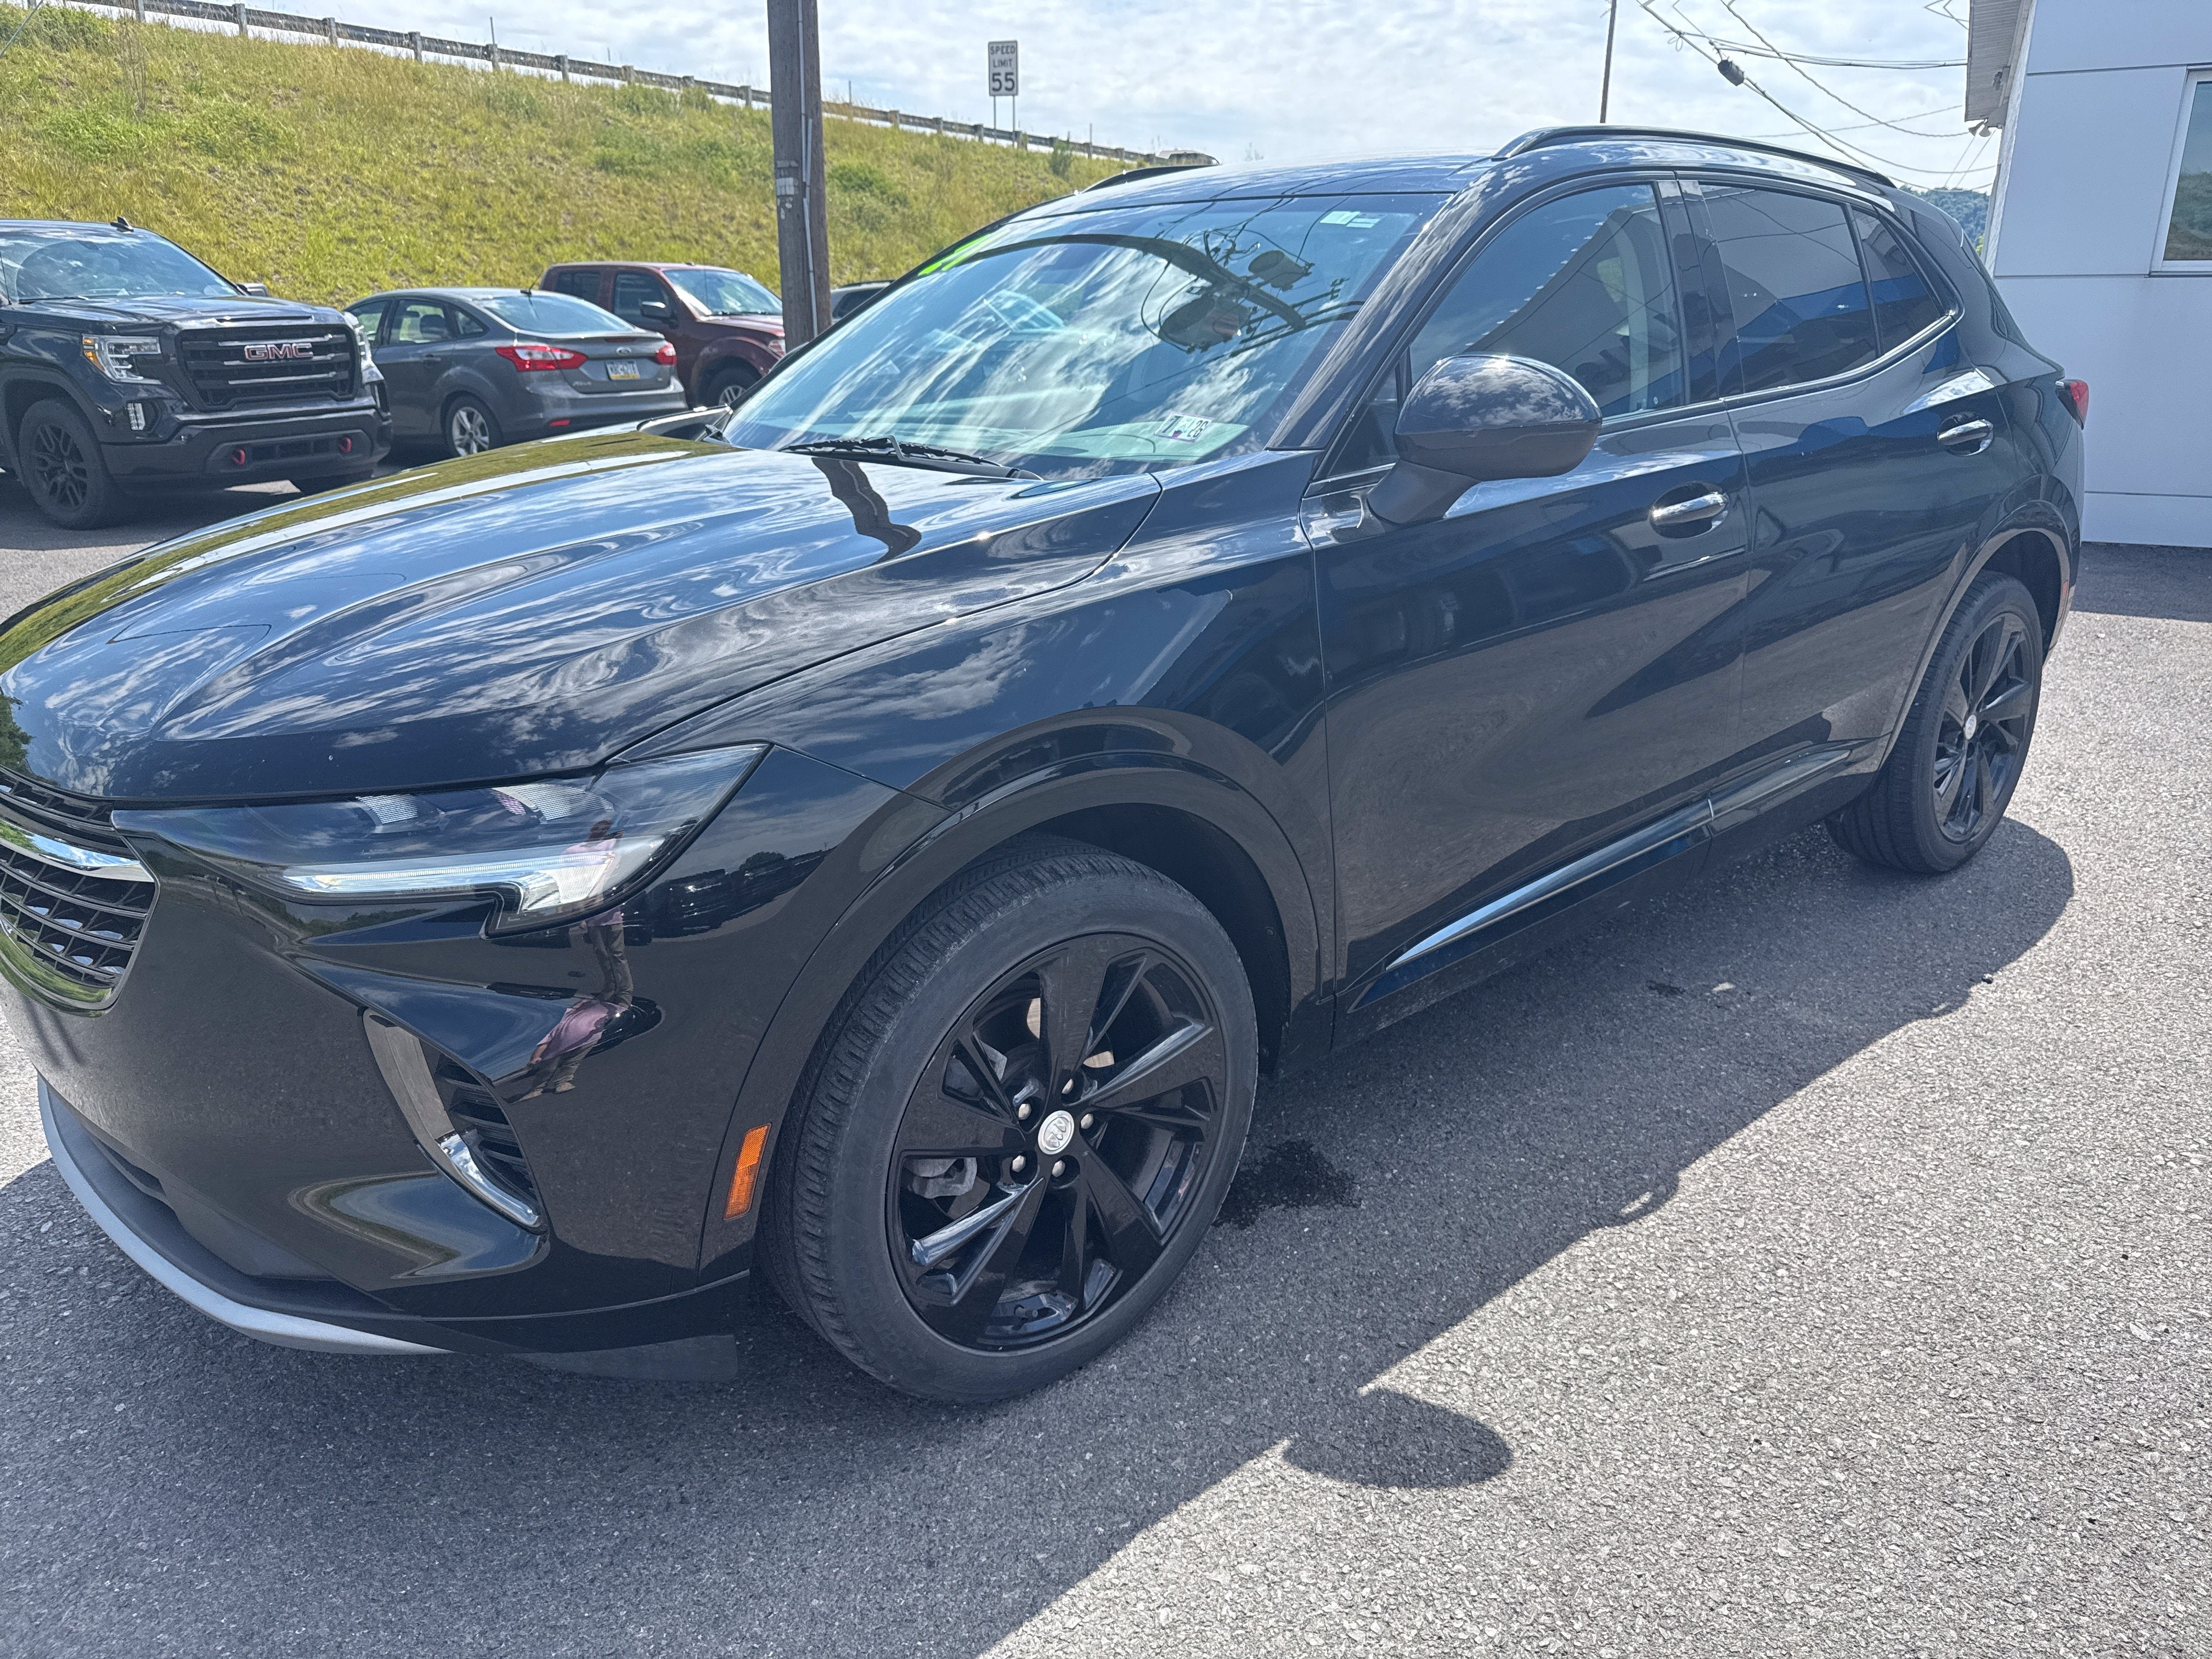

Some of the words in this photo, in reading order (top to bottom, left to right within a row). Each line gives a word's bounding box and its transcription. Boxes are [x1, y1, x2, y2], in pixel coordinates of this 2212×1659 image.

[990, 46, 1016, 55] SPEED
[992, 58, 1012, 68] LIMIT
[992, 72, 1015, 92] 55
[244, 342, 314, 360] GMC
[1162, 415, 1182, 433] 7
